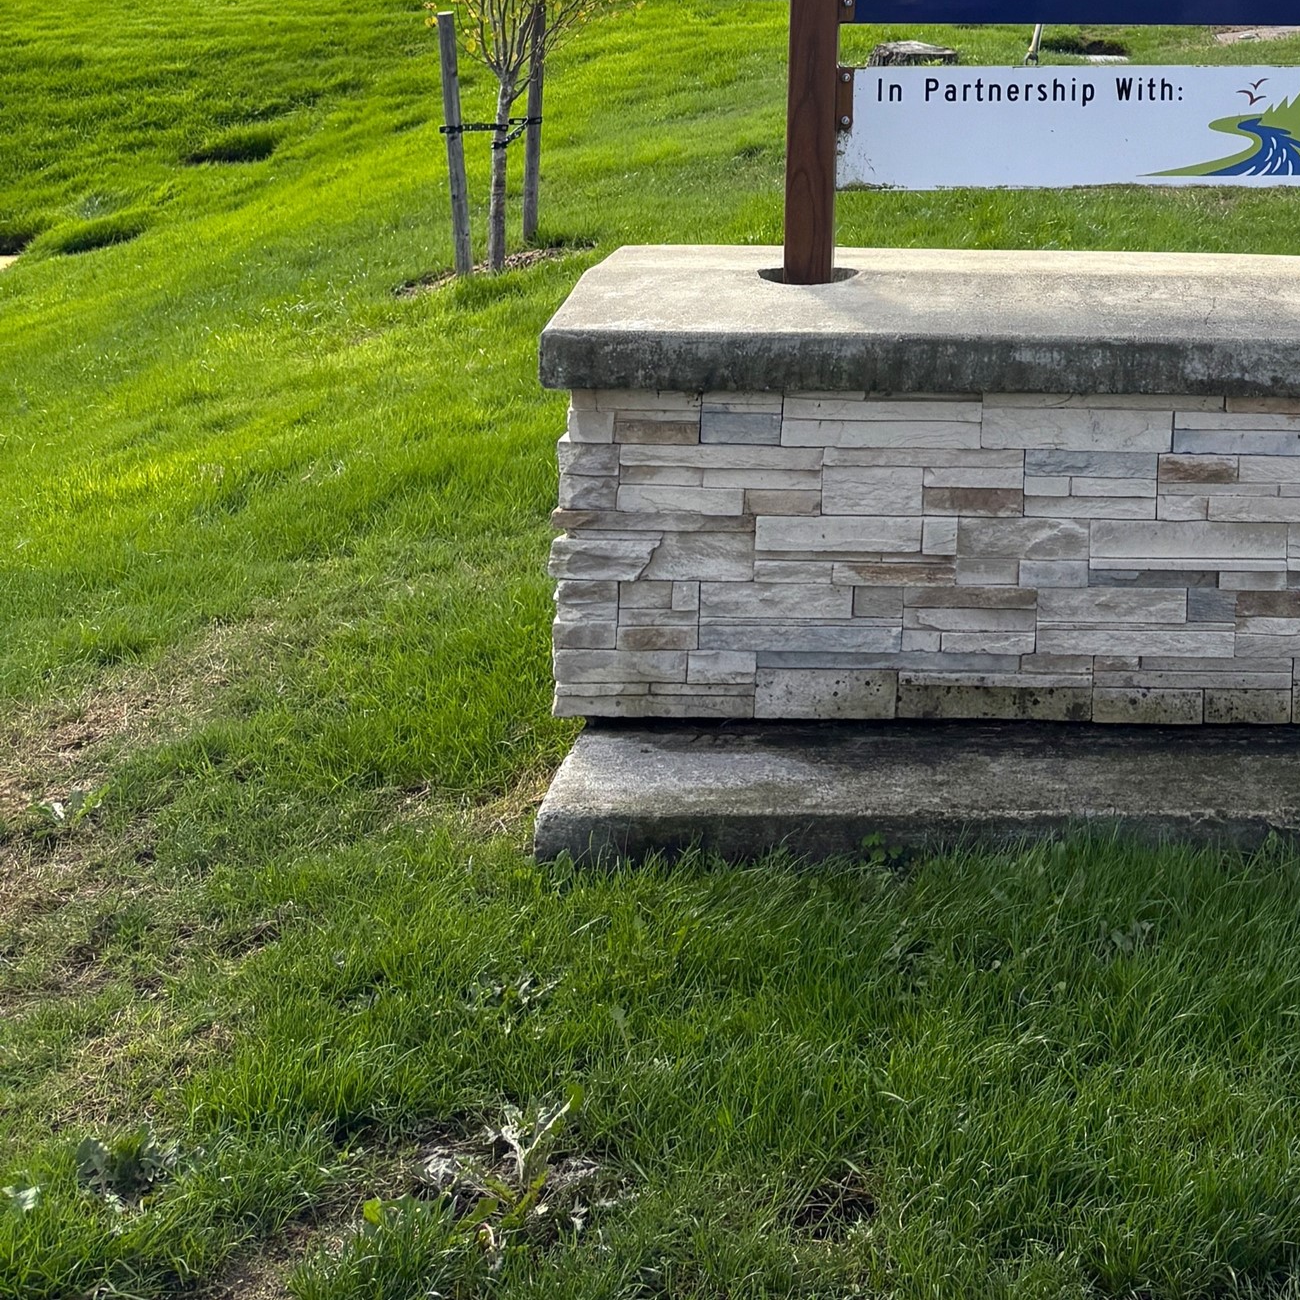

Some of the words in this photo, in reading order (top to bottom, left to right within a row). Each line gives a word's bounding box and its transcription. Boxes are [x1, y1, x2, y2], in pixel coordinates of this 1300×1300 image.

[878, 78, 902, 101] In
[925, 78, 1094, 107] Partnership
[1116, 77, 1182, 101] With:
